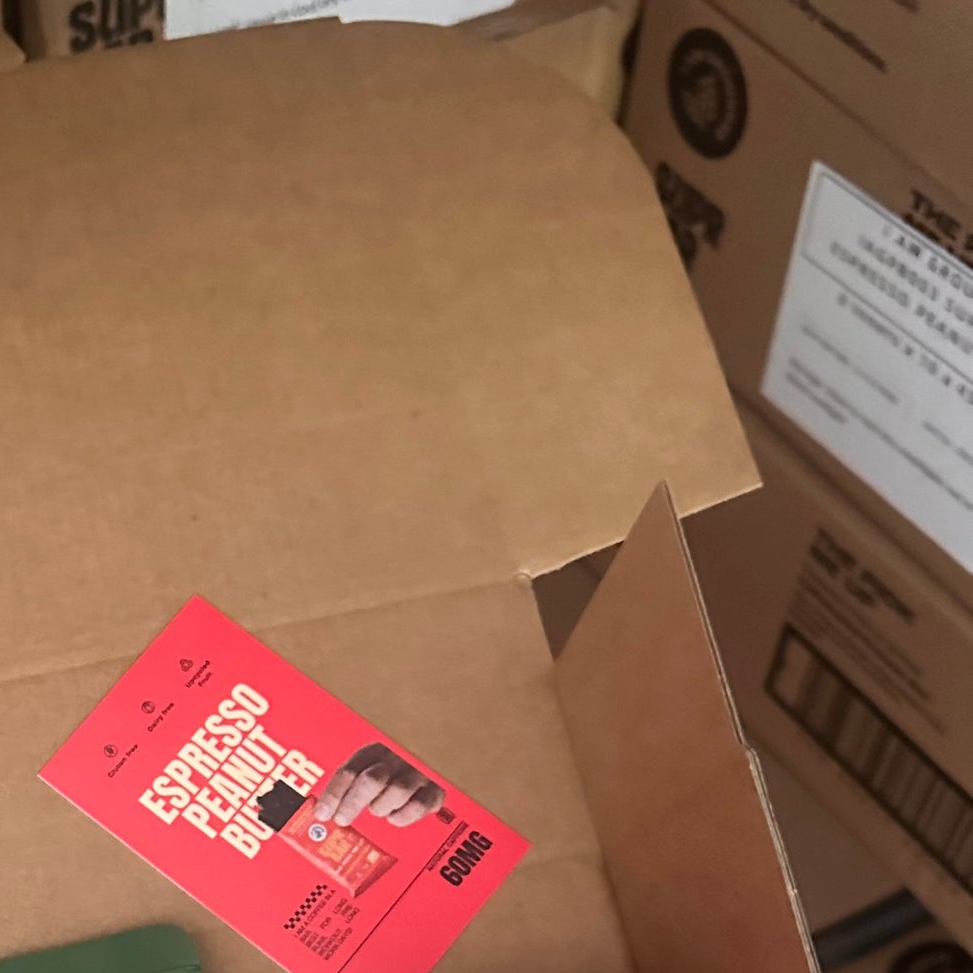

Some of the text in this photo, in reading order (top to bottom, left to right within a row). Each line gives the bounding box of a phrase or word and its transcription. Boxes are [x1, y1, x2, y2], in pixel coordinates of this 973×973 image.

[138, 683, 270, 826] ESPRESSO
[181, 724, 287, 840] PEANUT
[220, 750, 325, 860] BUER
[439, 830, 493, 887] 60MG
